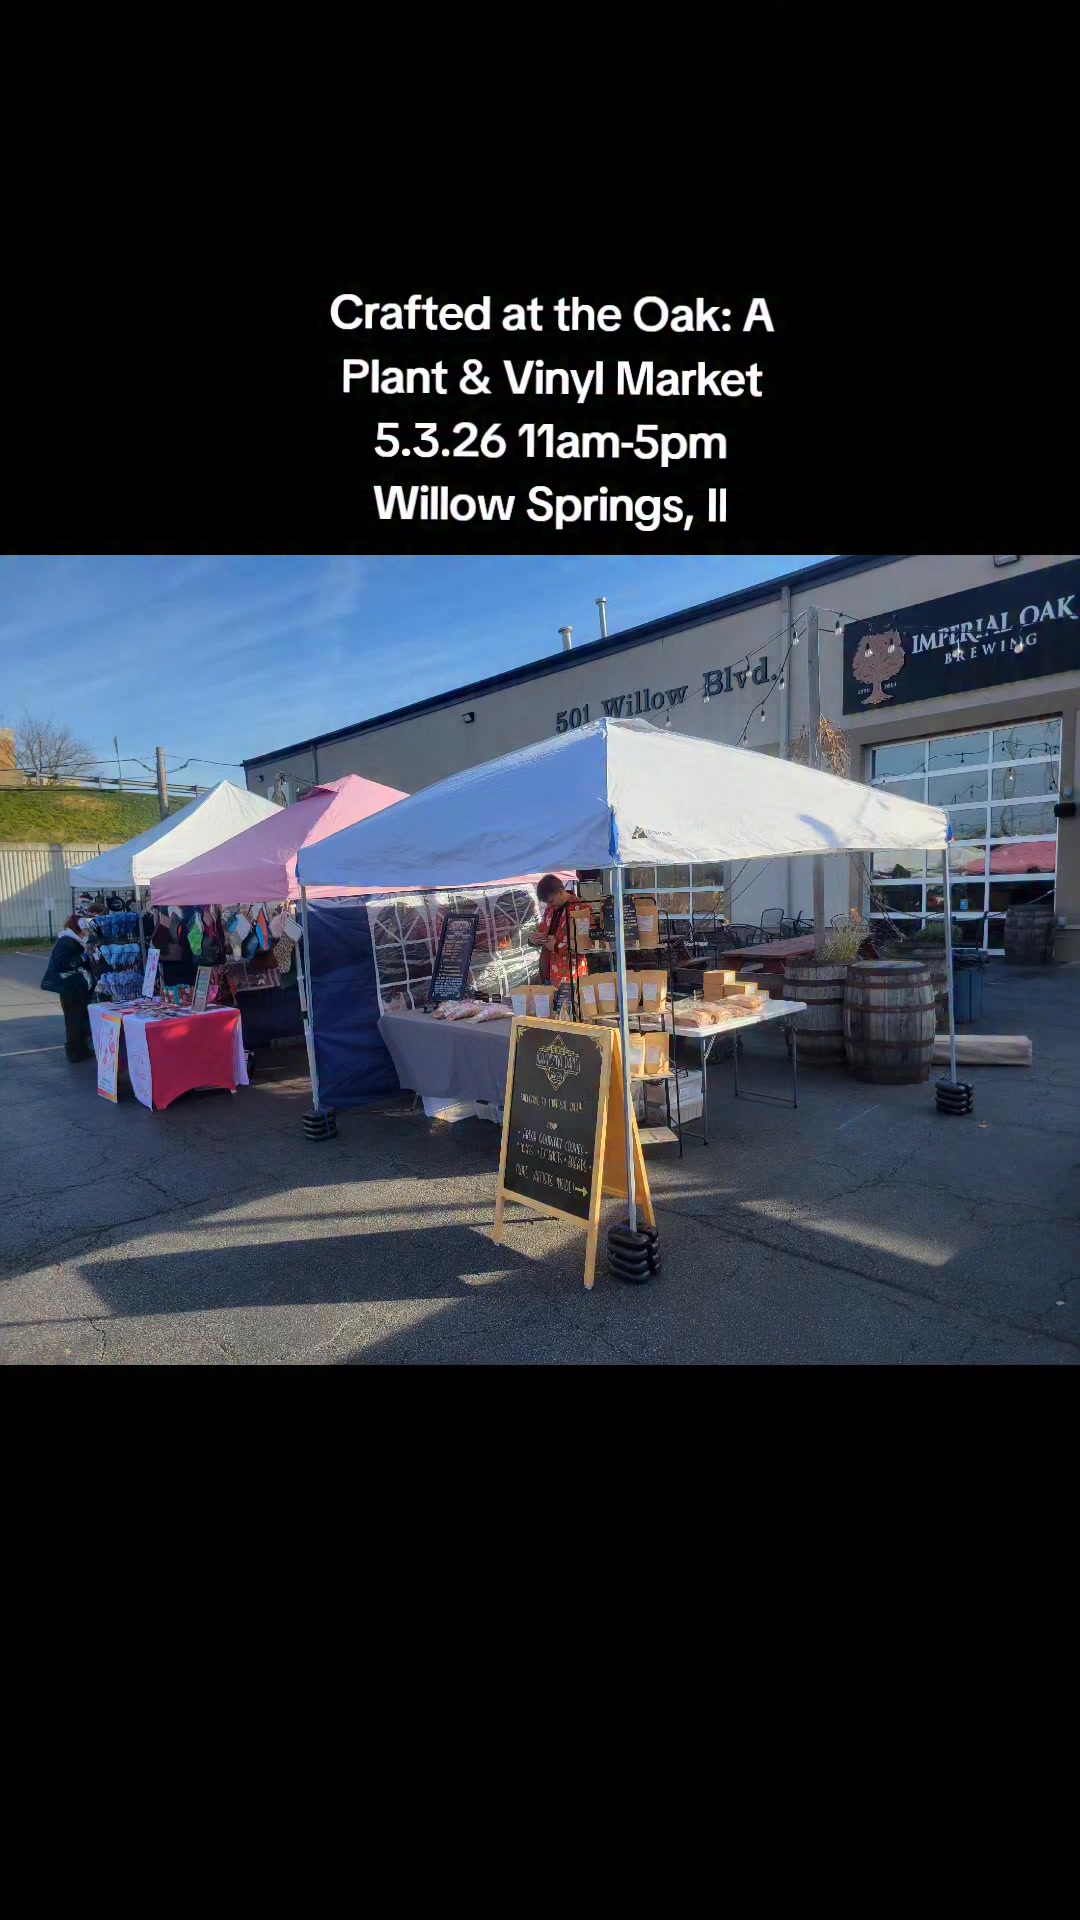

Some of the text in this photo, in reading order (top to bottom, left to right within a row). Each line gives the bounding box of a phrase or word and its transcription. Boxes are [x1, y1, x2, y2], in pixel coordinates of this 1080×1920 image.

[912, 595, 1079, 654] IMPERIAL OAK
[944, 632, 1038, 665] BREWING
[556, 656, 777, 733] 501 Willow Blvd.
